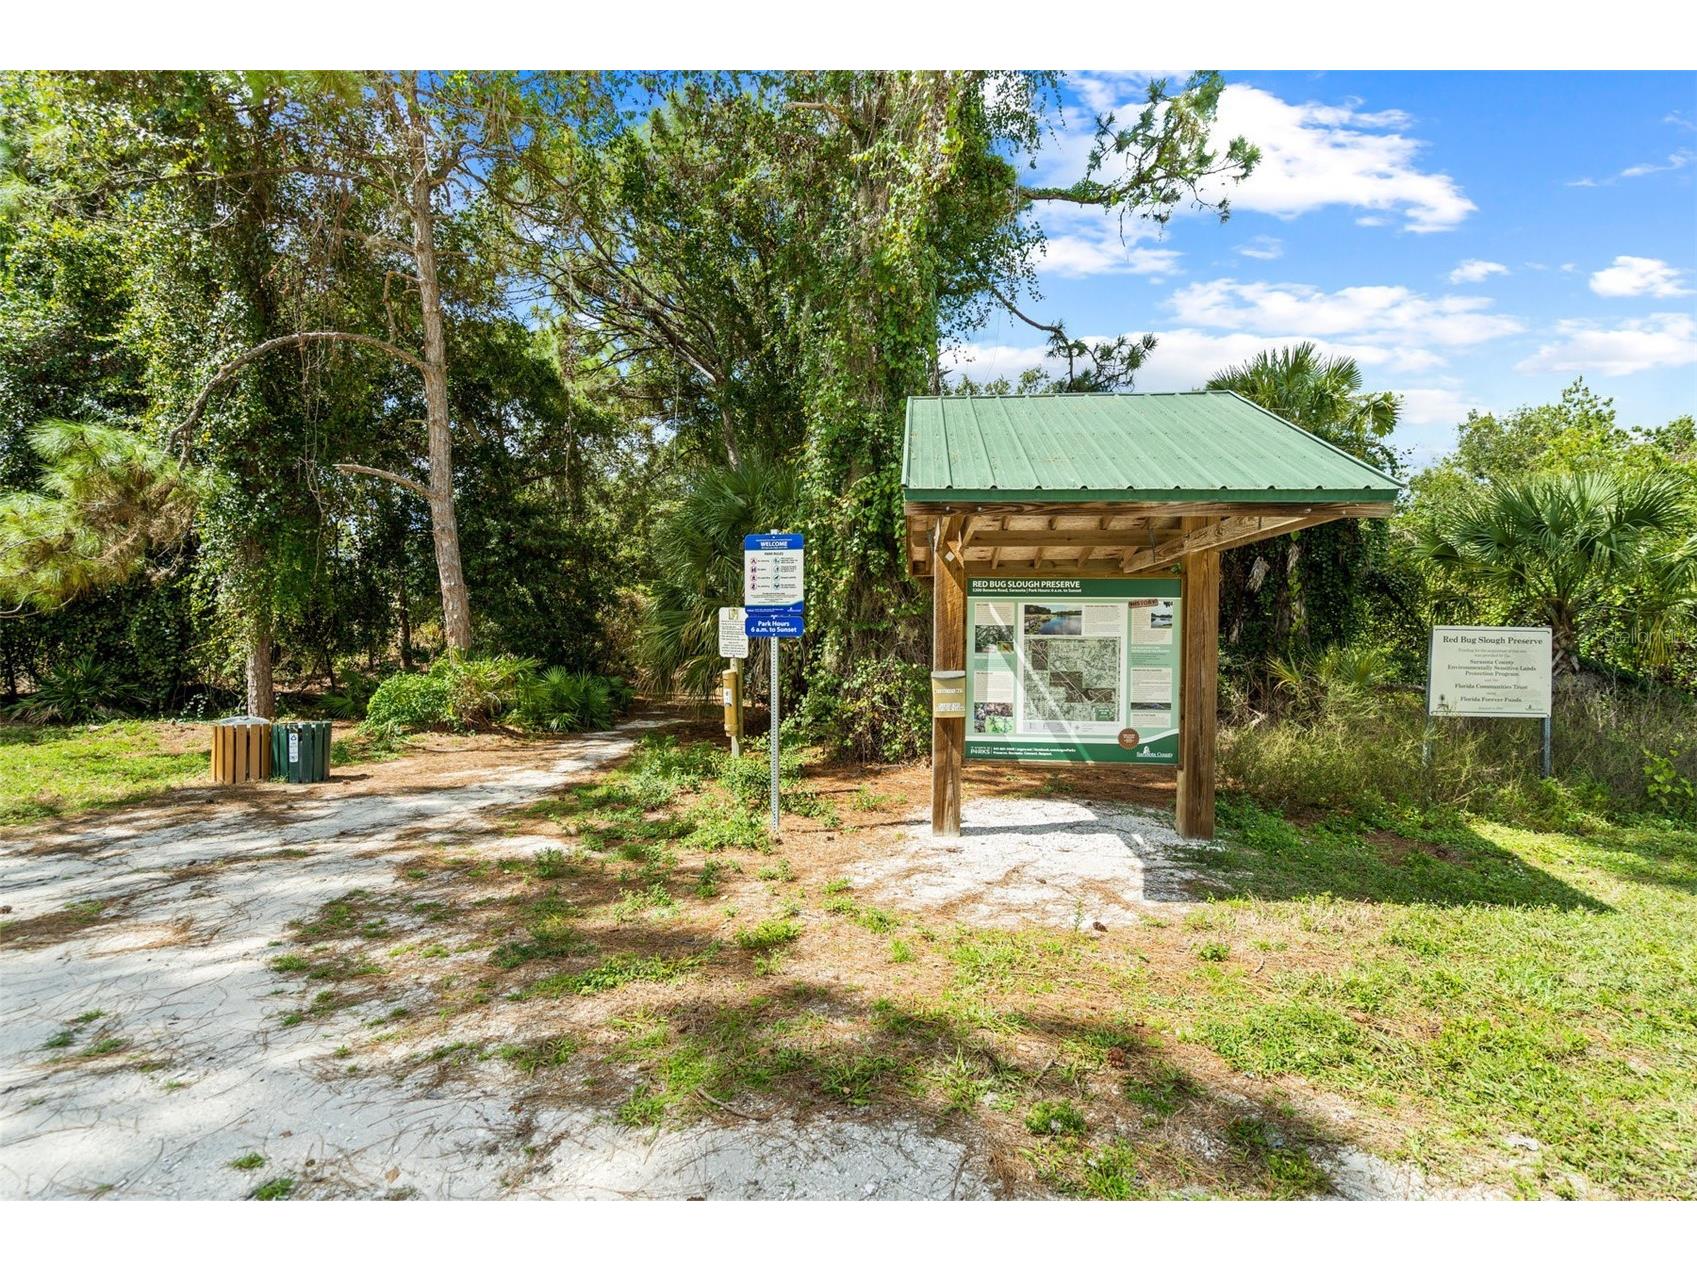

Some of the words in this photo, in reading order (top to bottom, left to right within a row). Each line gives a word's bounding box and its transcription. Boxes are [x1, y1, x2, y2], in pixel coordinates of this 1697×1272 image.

[972, 580, 989, 588] RED
[989, 580, 1007, 588] BUG
[1007, 580, 1040, 588] SLOUGH
[1041, 580, 1081, 588] PRESERVE
[1460, 636, 1477, 644] Bug
[1478, 636, 1506, 645] Slough
[1507, 637, 1543, 645] Preserve
